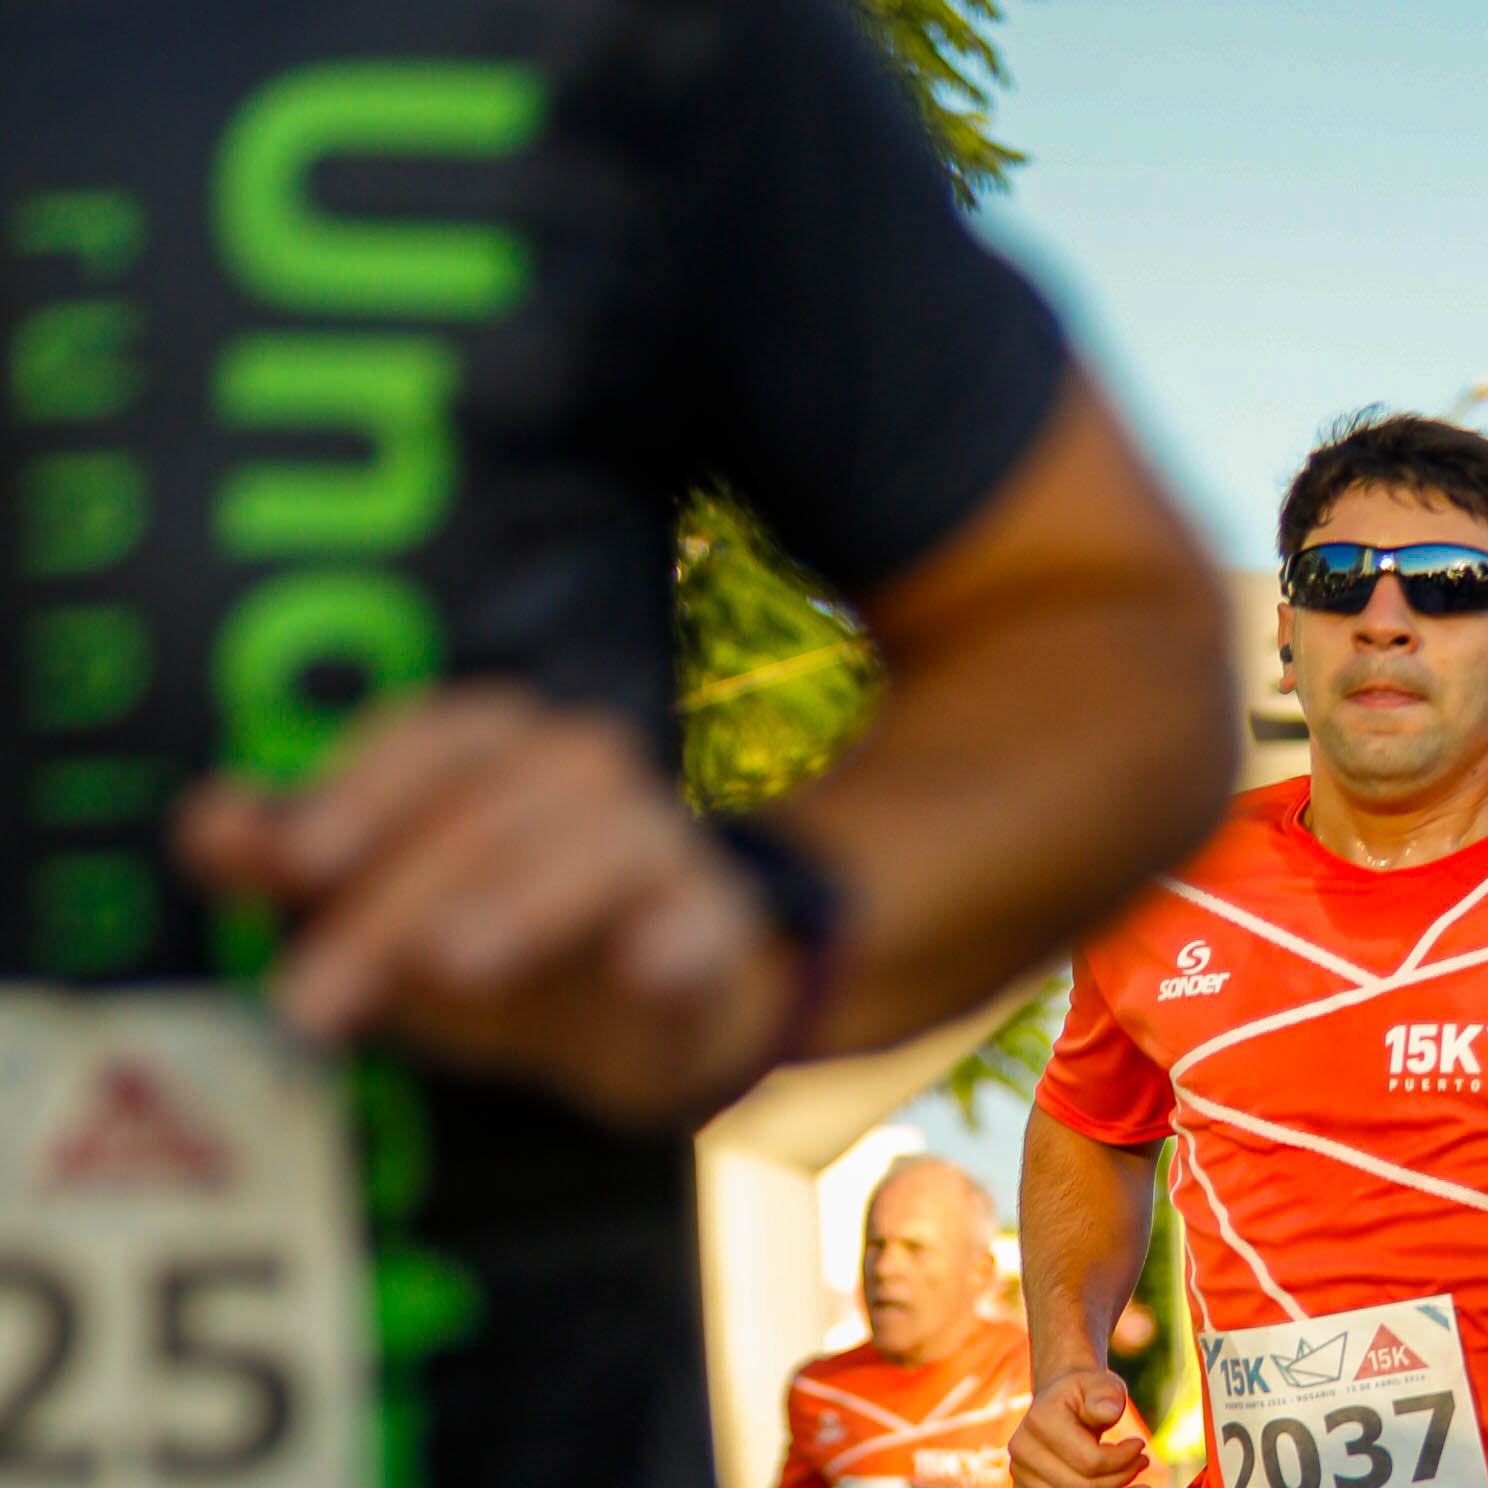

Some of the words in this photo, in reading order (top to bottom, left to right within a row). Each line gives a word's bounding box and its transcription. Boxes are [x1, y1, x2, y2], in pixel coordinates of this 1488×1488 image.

[1385, 1023, 1484, 1075] 15K
[1389, 1078, 1481, 1093] PUERTO
[1367, 1345, 1411, 1372] 15K
[1220, 1355, 1271, 1397] 15K
